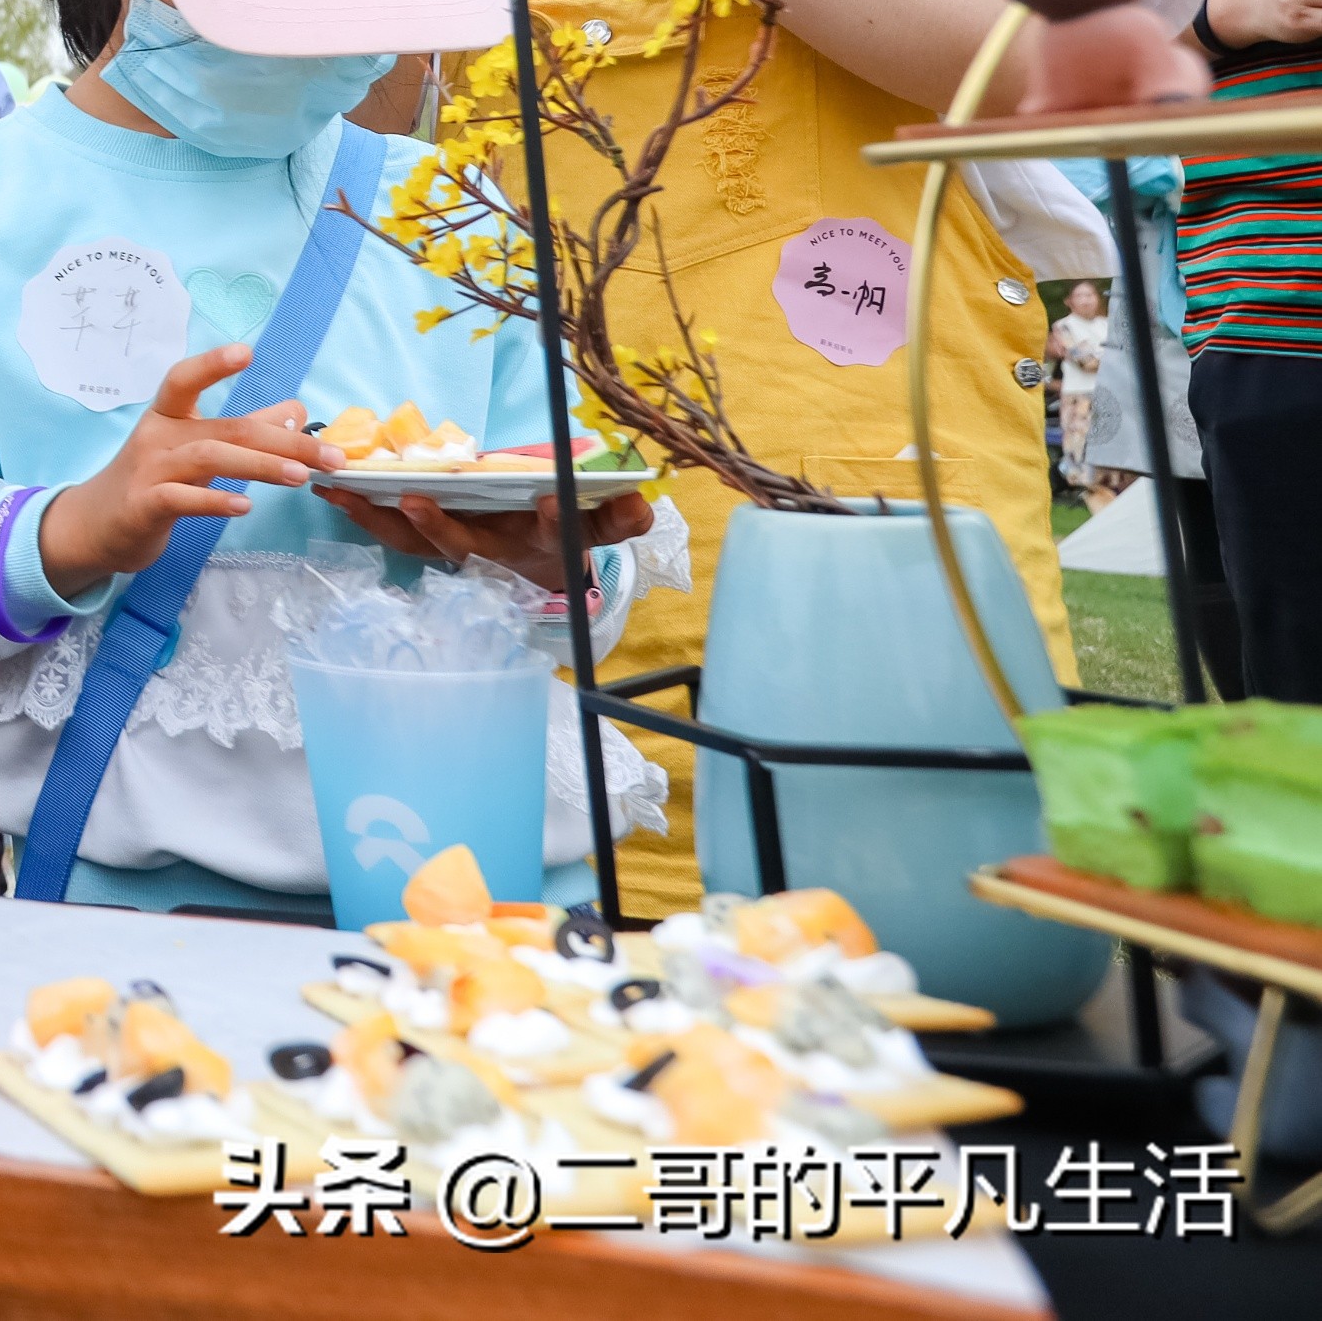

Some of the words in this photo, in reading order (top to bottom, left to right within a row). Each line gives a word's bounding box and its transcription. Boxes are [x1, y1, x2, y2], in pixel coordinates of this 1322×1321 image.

[809, 229, 835, 247] NICE
[839, 228, 854, 237] TO
[858, 230, 888, 249] MEET
[54, 258, 83, 282] NICE
[86, 251, 103, 262] TO
[108, 250, 141, 265] MEET
